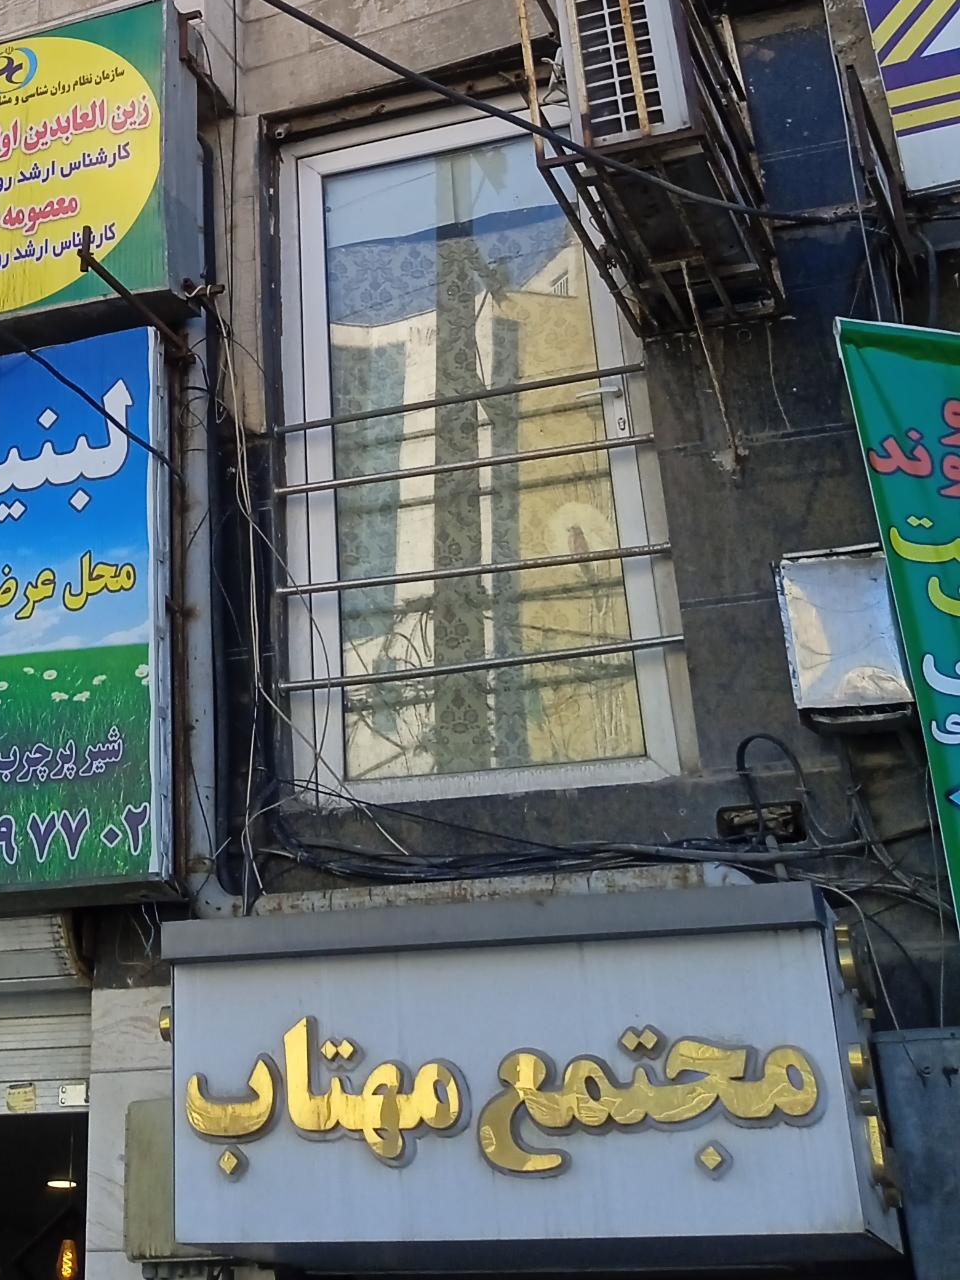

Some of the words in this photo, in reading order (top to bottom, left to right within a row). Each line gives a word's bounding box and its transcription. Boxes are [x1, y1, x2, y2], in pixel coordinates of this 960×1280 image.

[21, 83, 49, 103] شناسی
[50, 80, 71, 96] روان
[72, 73, 93, 92] نظام
[94, 66, 125, 86] سازمان
[23, 97, 106, 151] العابدین
[110, 94, 151, 133] زین
[17, 160, 56, 184] ارشد
[60, 141, 132, 178] کارشناس
[2, 195, 79, 233] معصومه
[13, 238, 49, 263] ارشد
[62, 549, 137, 612] محل
[50, 738, 76, 780] پر
[77, 725, 124, 777] شیر
[26, 806, 90, 864] ۷۷
[185, 1014, 465, 1177] مهتاب
[475, 1023, 823, 1174] مجتمع
